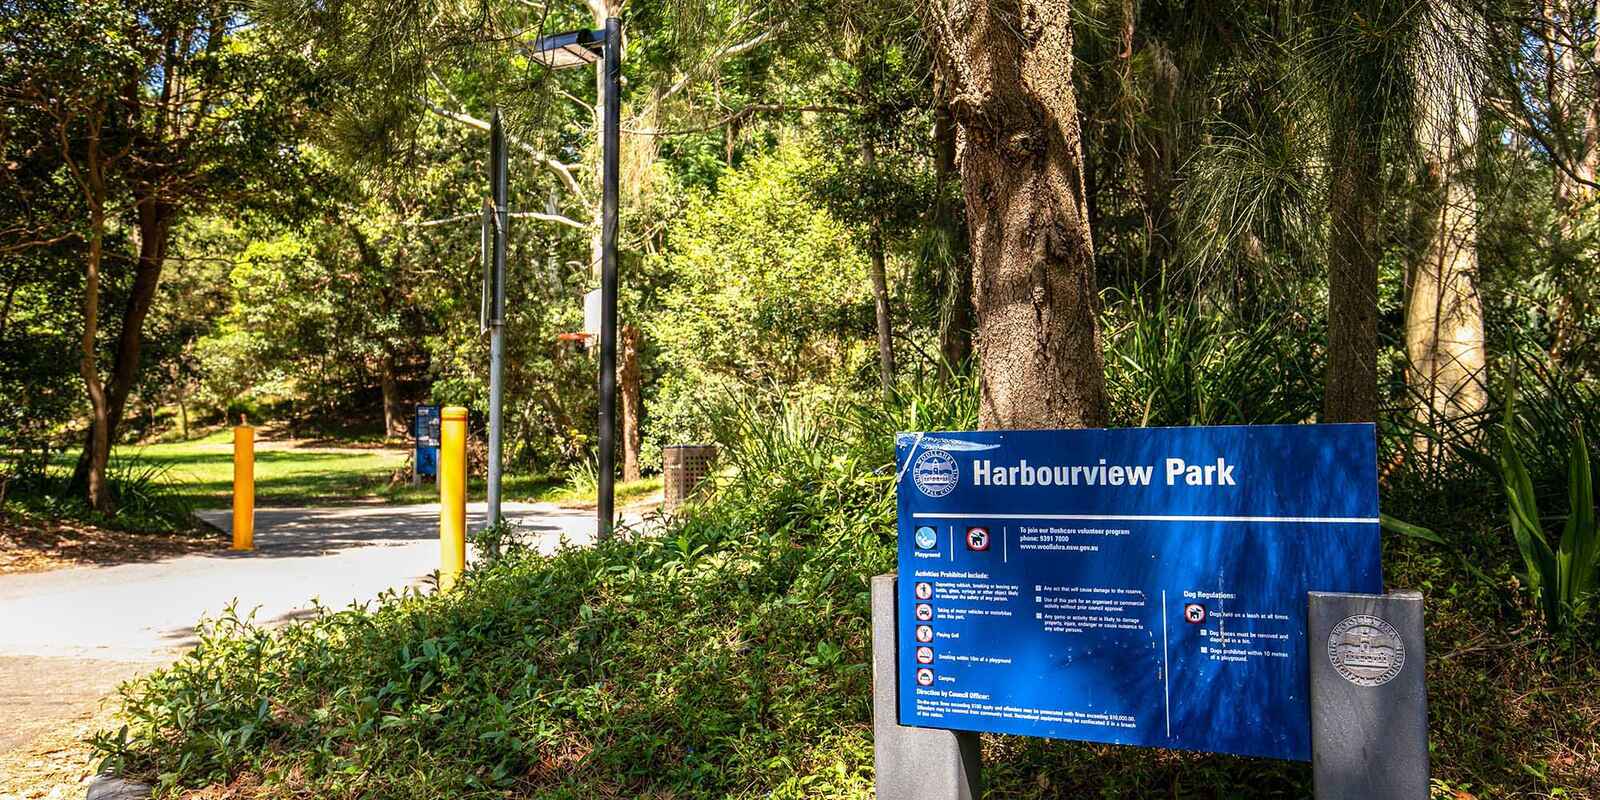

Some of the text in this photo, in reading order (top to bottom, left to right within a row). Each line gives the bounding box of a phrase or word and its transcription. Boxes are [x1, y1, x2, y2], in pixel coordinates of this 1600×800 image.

[973, 458, 1153, 486] Harbourview
[1166, 458, 1236, 486] Park
[1028, 526, 1038, 534] join
[914, 570, 940, 578] Activities
[940, 570, 967, 578] Prohibited
[1183, 590, 1236, 600] Dog Regulations:
[938, 674, 956, 682] Camping
[916, 688, 990, 700] Direction by Council Officer:
